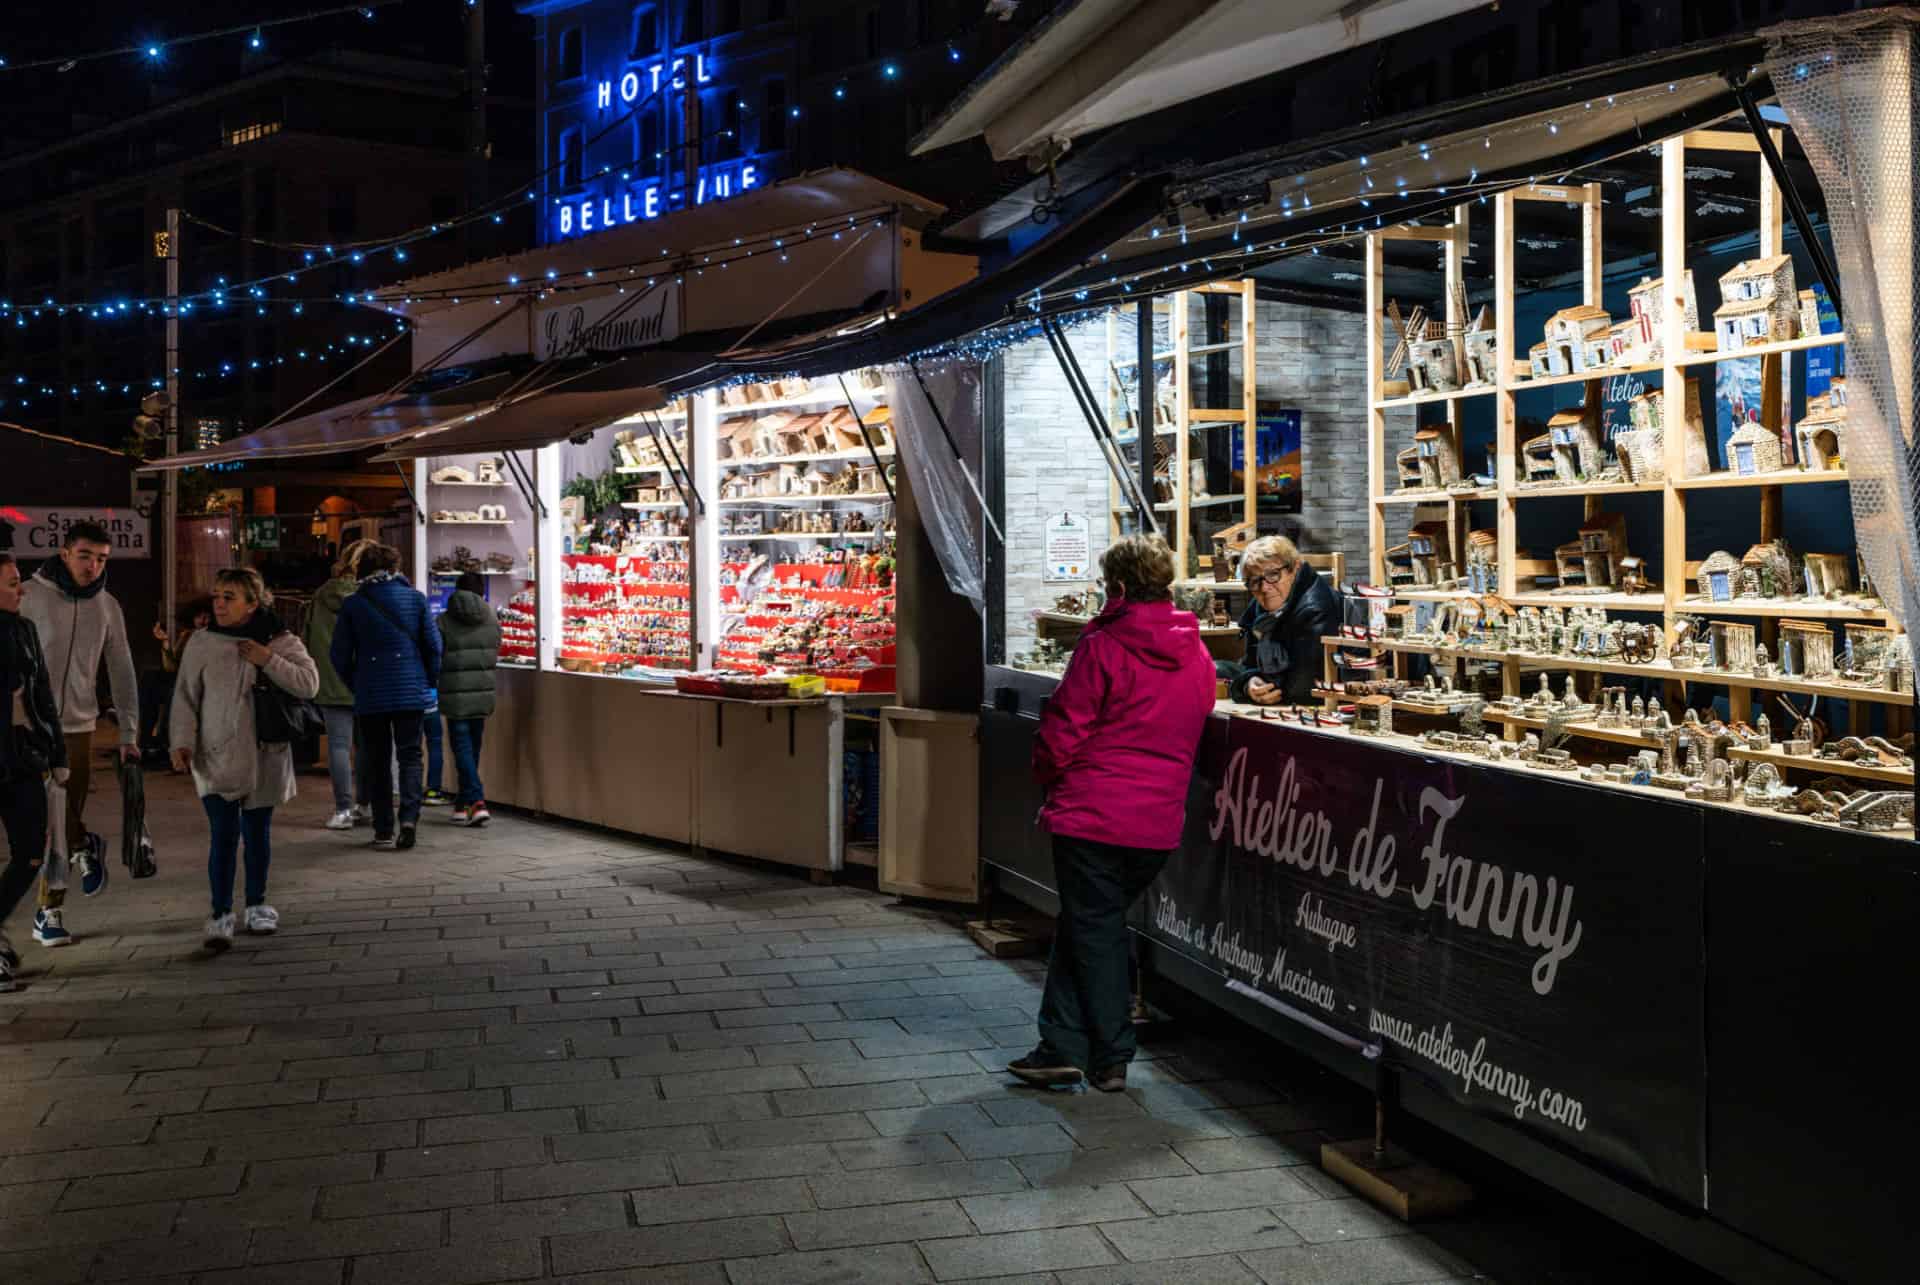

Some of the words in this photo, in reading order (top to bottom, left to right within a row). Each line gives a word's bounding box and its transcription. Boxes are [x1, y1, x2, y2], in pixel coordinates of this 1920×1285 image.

[599, 53, 711, 109] HOTEL
[29, 526, 144, 549] Cana
[1209, 746, 1338, 876] Atelier
[1348, 777, 1398, 899] de
[1411, 785, 1583, 995] Fanny
[1295, 891, 1357, 952] Aubagne
[1208, 920, 1265, 988] Anthony
[1369, 1007, 1587, 1132] www.atelierfanny.com
